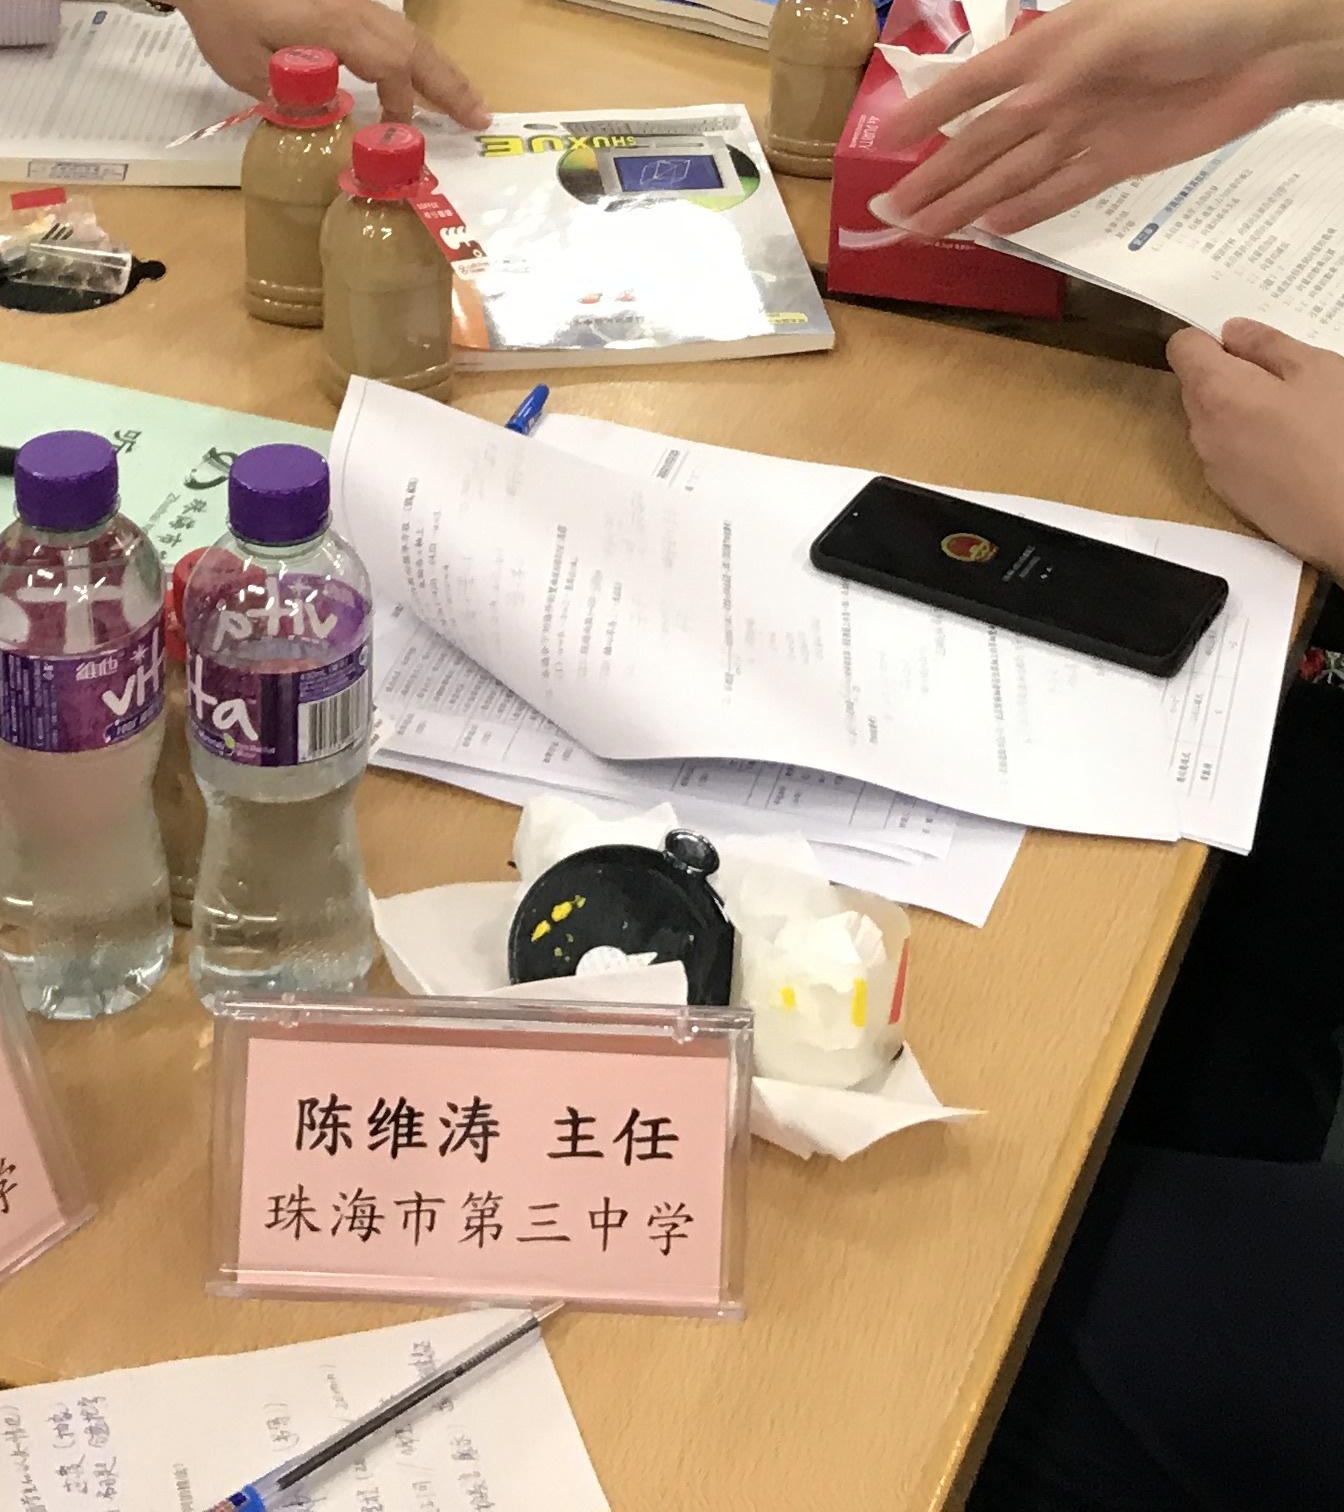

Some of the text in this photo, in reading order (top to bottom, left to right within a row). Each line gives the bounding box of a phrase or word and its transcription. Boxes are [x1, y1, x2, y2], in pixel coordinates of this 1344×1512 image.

[477, 133, 637, 157] SHUXUE
[295, 1093, 681, 1167] 陈维涛 主任
[264, 1183, 695, 1257] 珠海市第三中学
